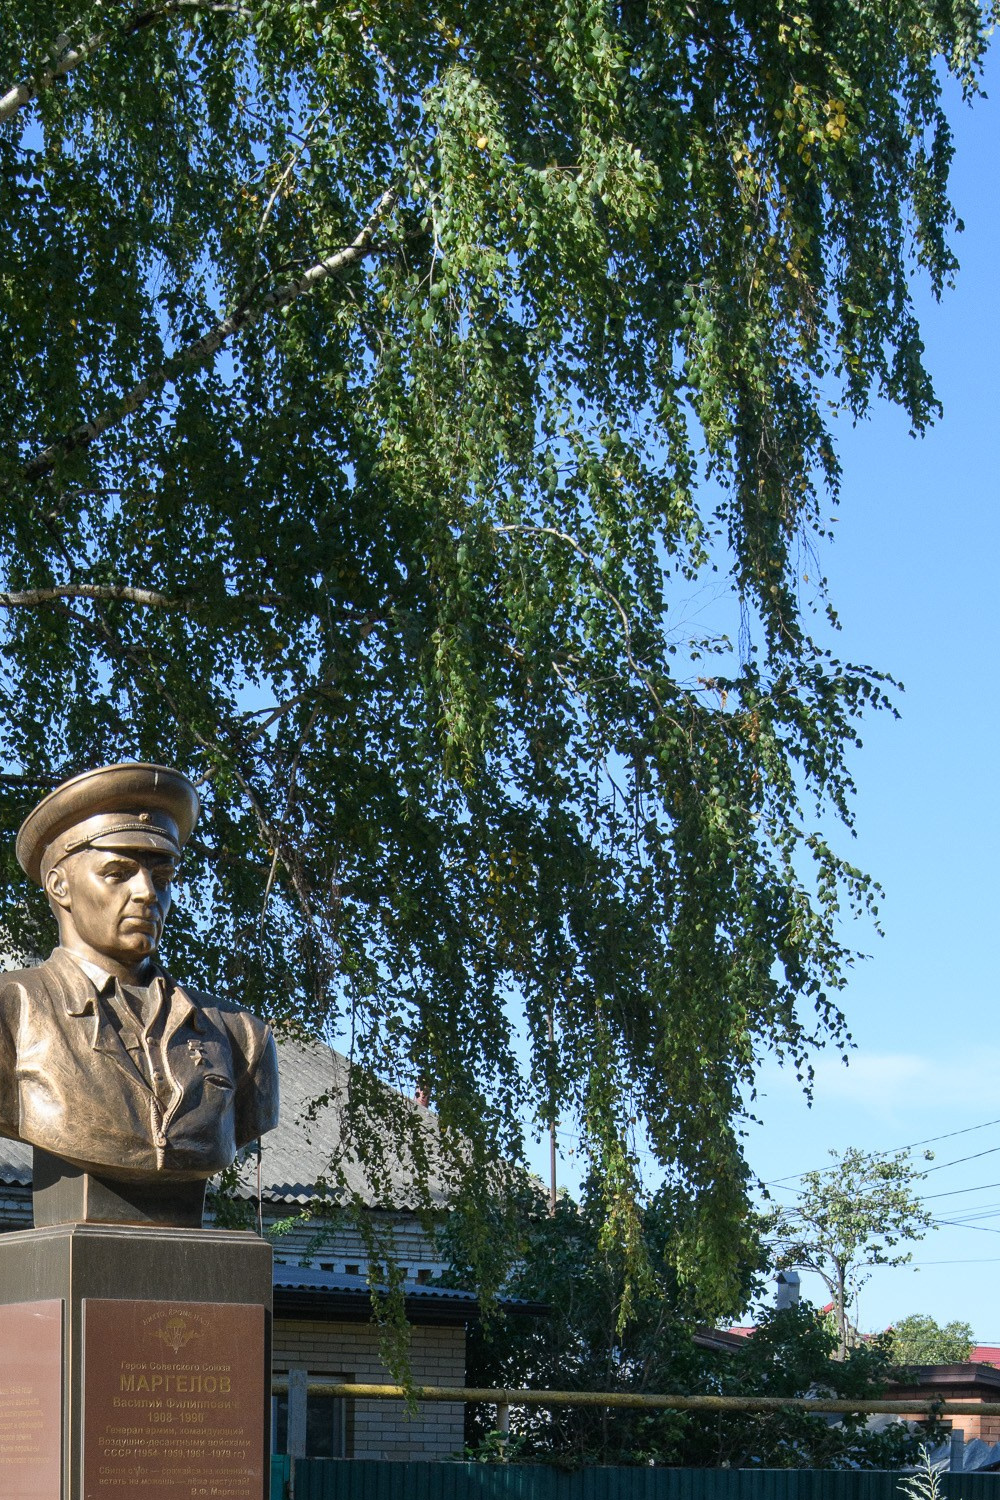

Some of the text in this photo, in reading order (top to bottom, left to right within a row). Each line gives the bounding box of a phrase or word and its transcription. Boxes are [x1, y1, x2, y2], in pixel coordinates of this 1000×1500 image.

[121, 1361, 231, 1371] Герой Советского Союза
[119, 1374, 231, 1393] МАРГЕЛОВ
[113, 1397, 163, 1408] Василий
[105, 1425, 143, 1435] Генерал
[208, 1438, 251, 1447] войсками
[104, 1449, 132, 1458] СССР
